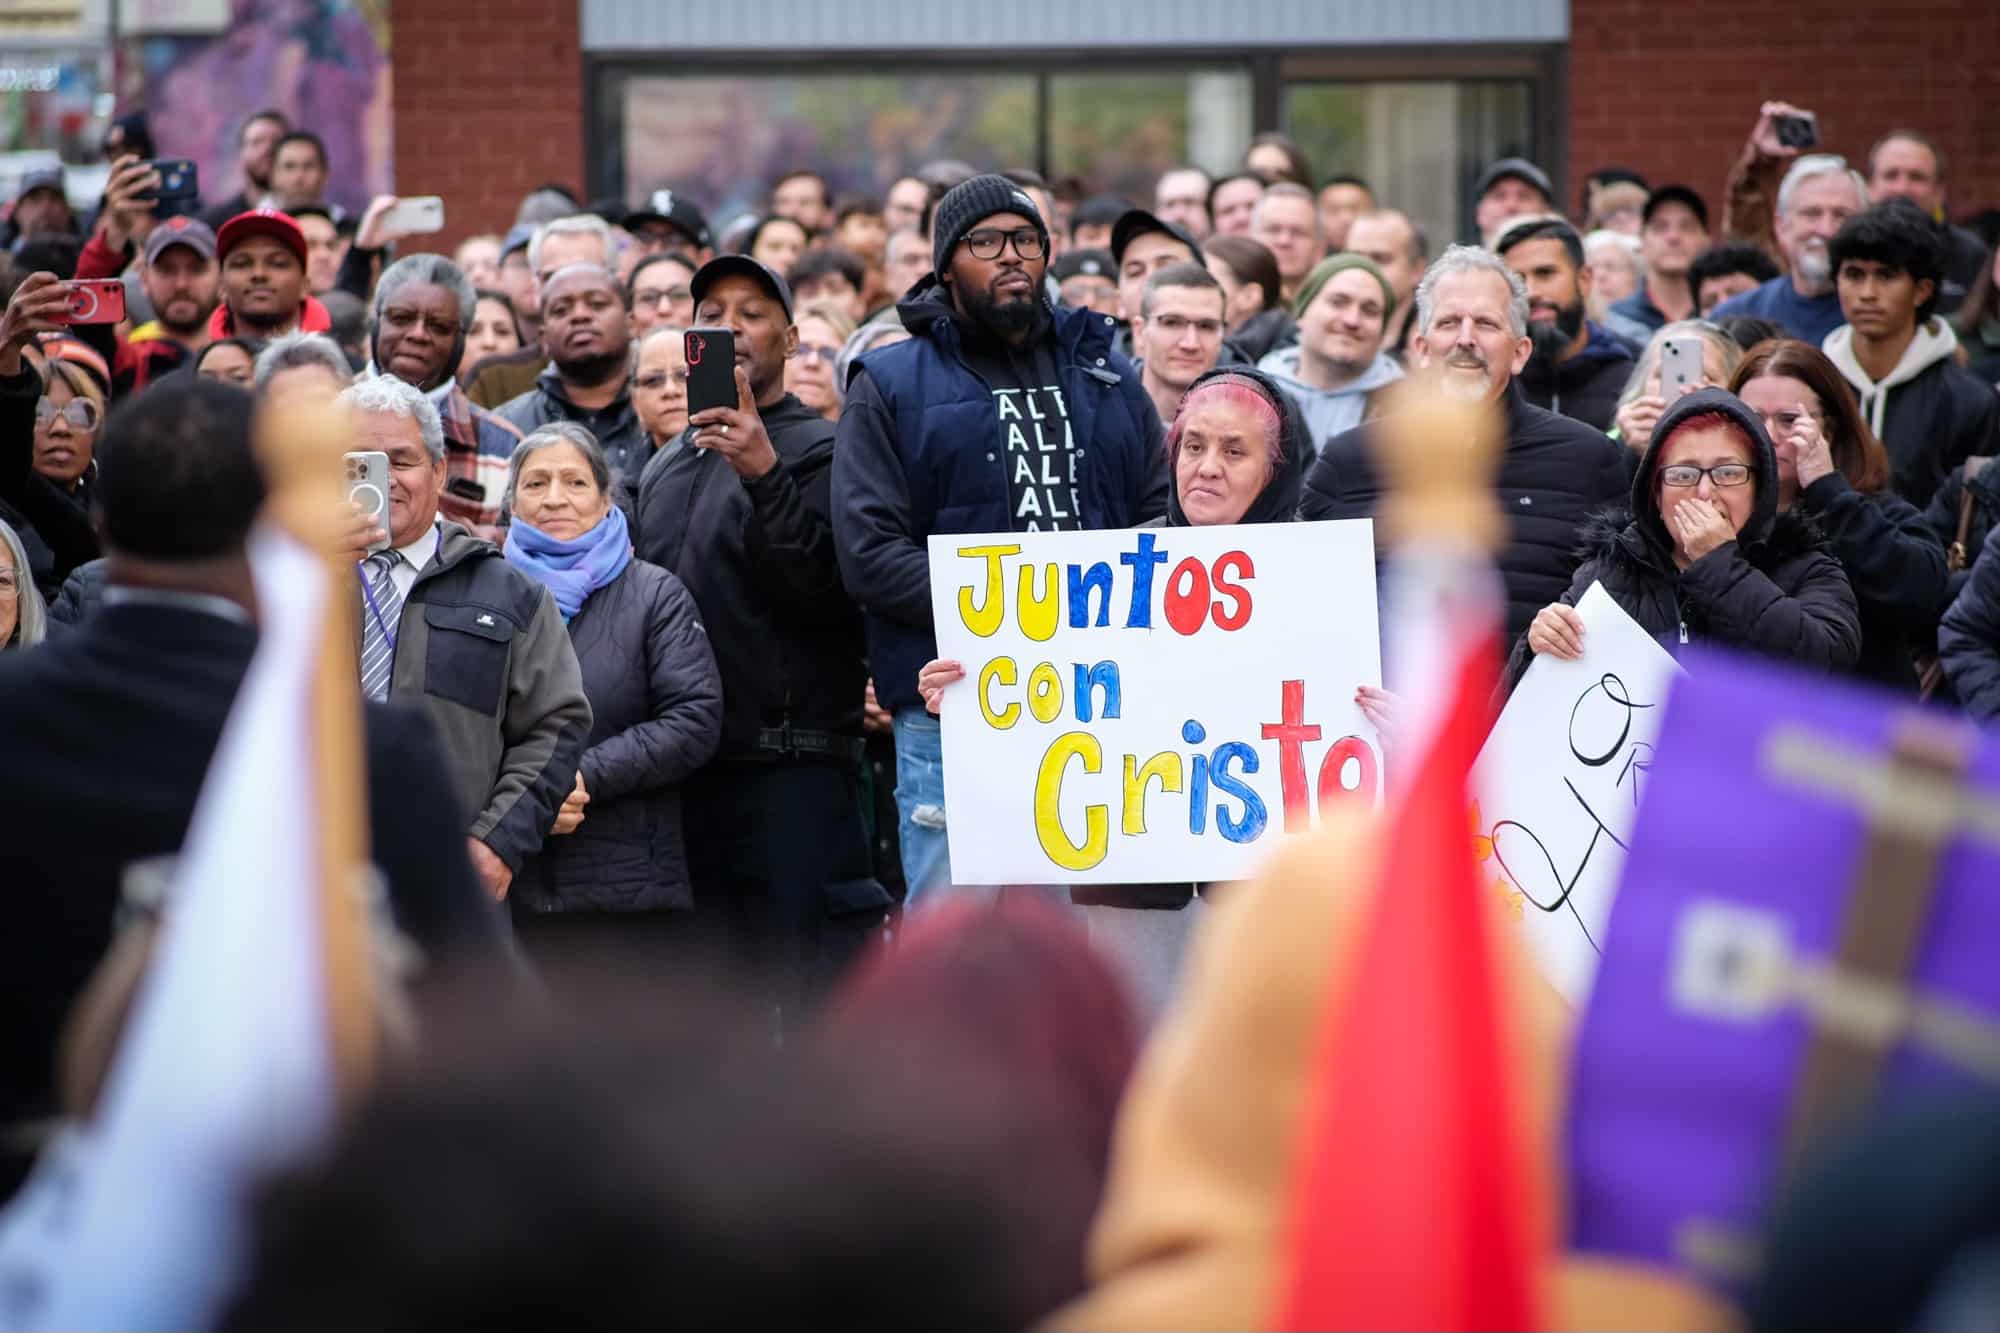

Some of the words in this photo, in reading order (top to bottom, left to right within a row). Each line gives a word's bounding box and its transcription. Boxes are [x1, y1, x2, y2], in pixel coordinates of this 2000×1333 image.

[957, 533, 1255, 641] Juntos
[979, 656, 1121, 730] con
[1034, 680, 1378, 871] Cristo
